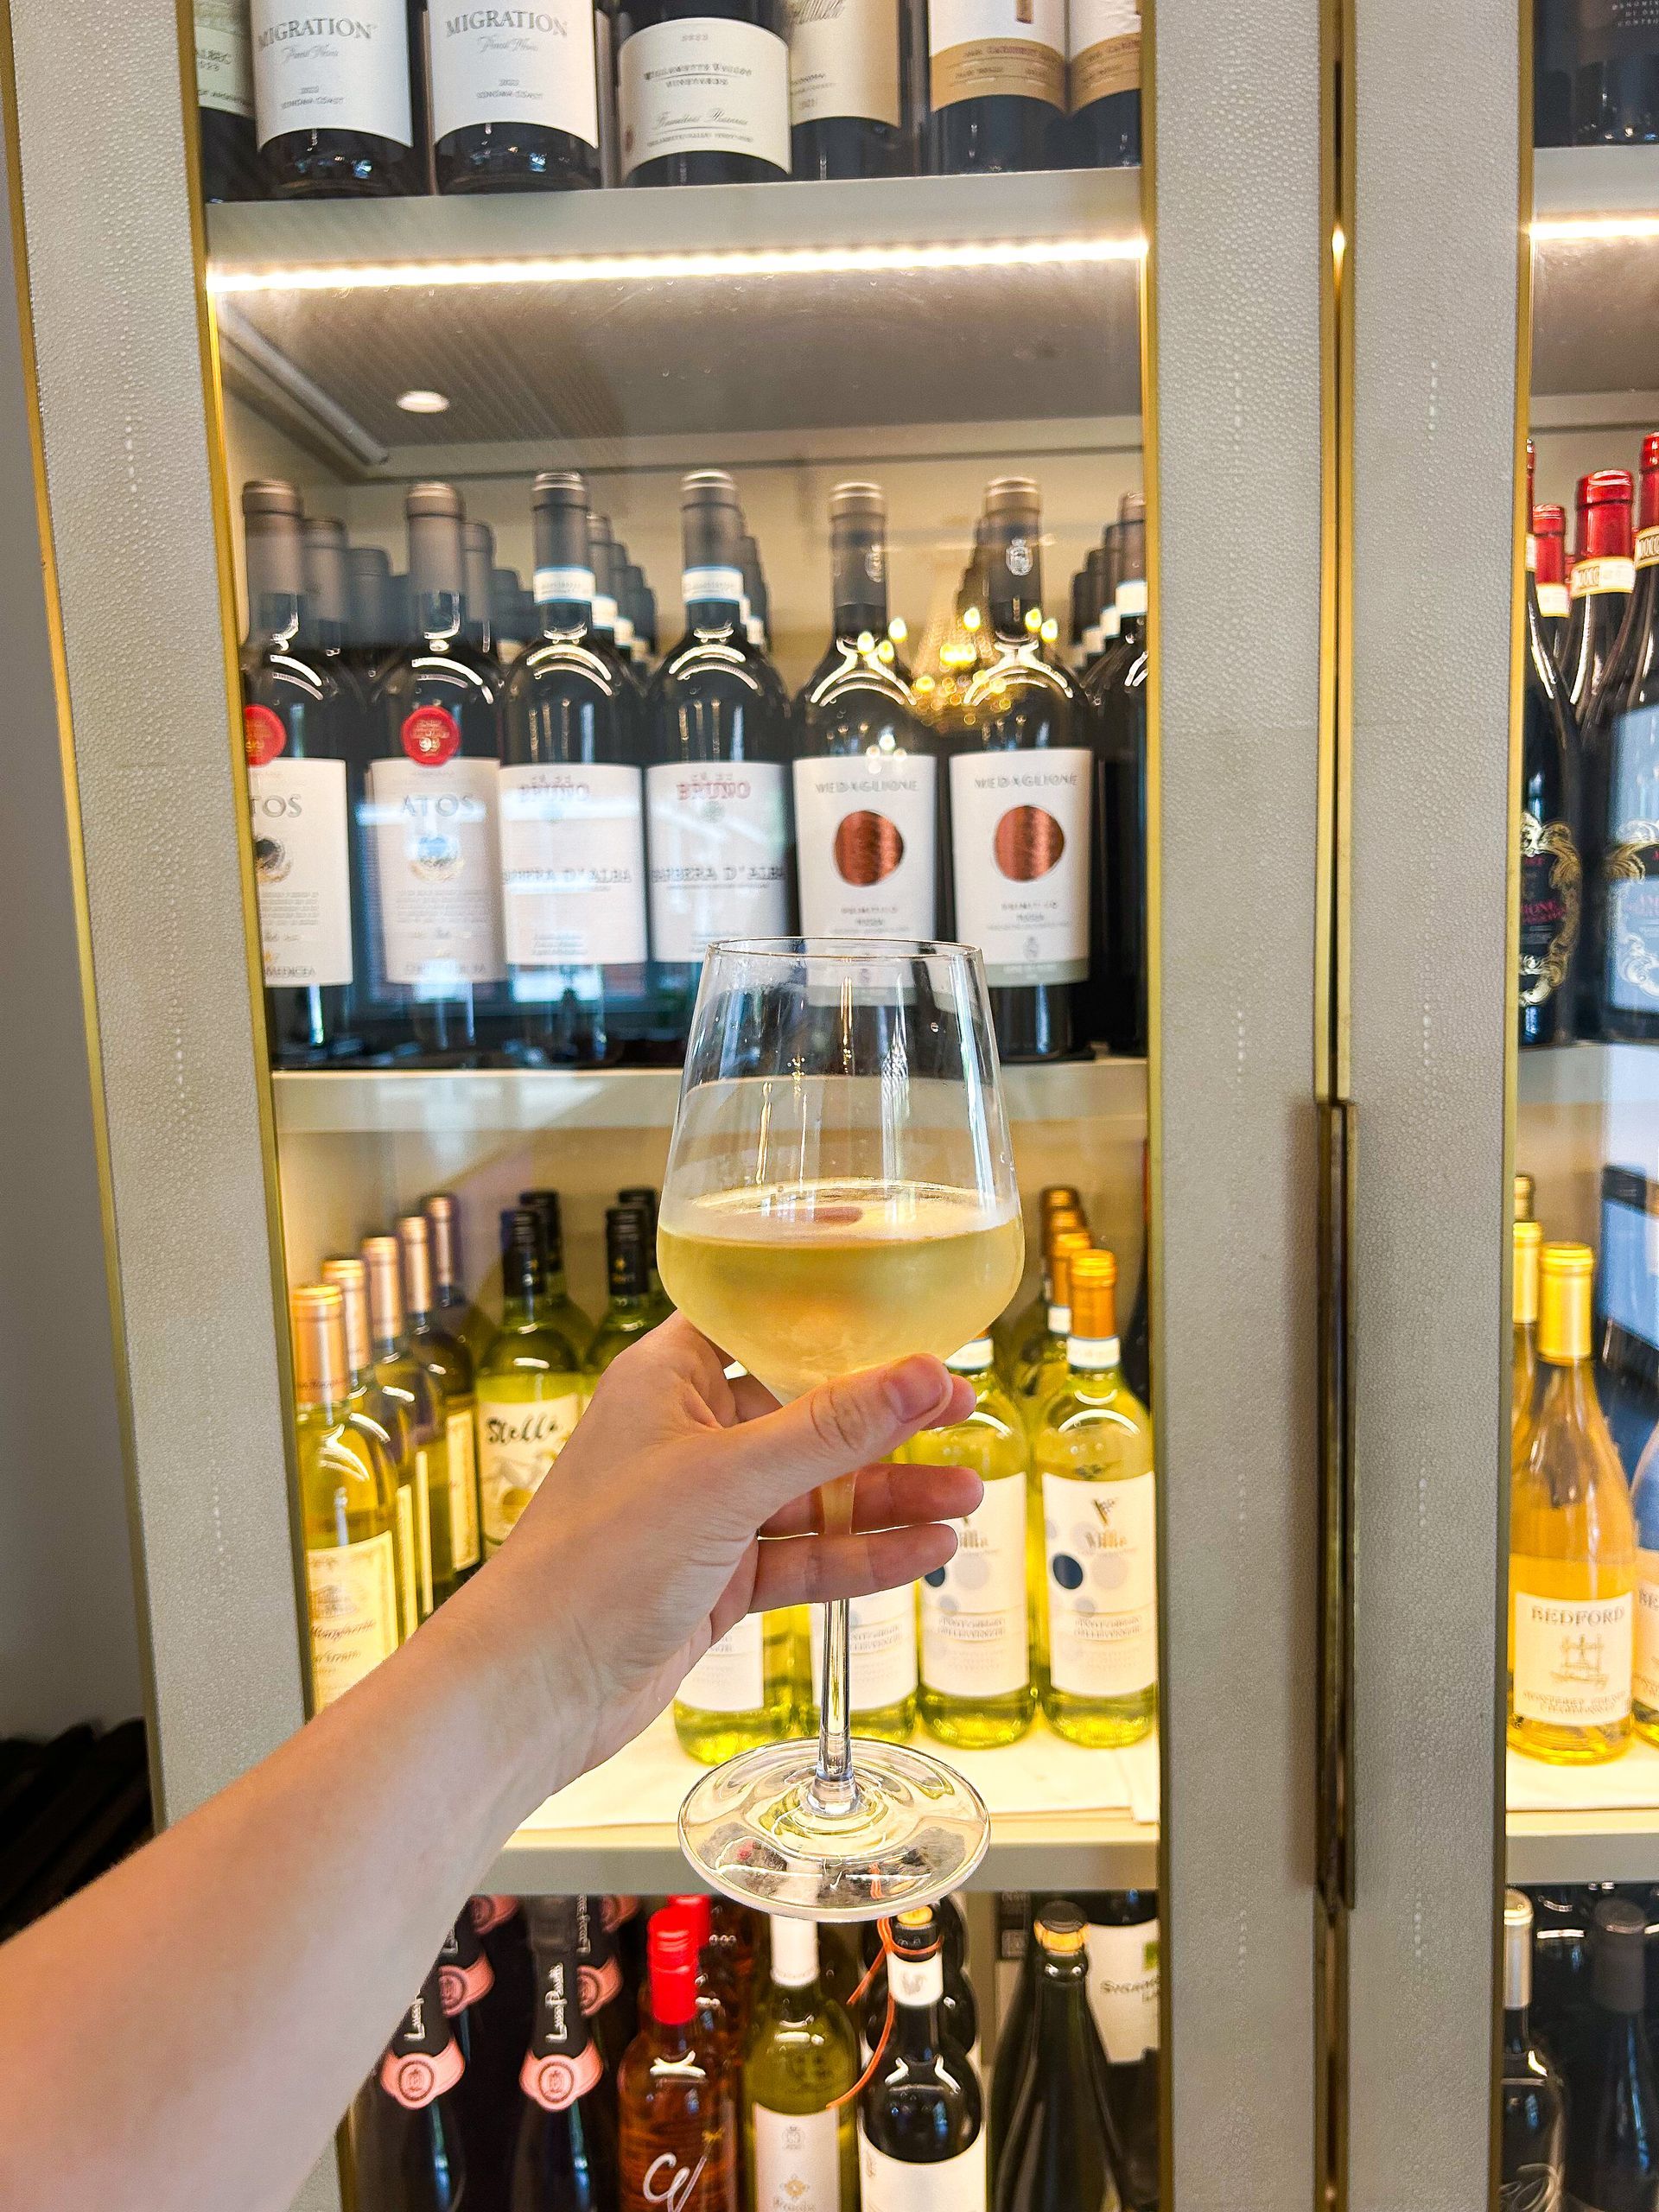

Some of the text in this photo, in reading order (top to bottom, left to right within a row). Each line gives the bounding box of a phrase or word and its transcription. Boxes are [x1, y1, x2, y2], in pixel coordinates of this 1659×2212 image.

[257, 17, 375, 50] MIGRATION
[445, 10, 568, 37] MIGRATION
[676, 781, 752, 801] BRUNO
[249, 794, 302, 818] TOS
[401, 794, 480, 817] ATOS
[958, 1528, 989, 1549] illa
